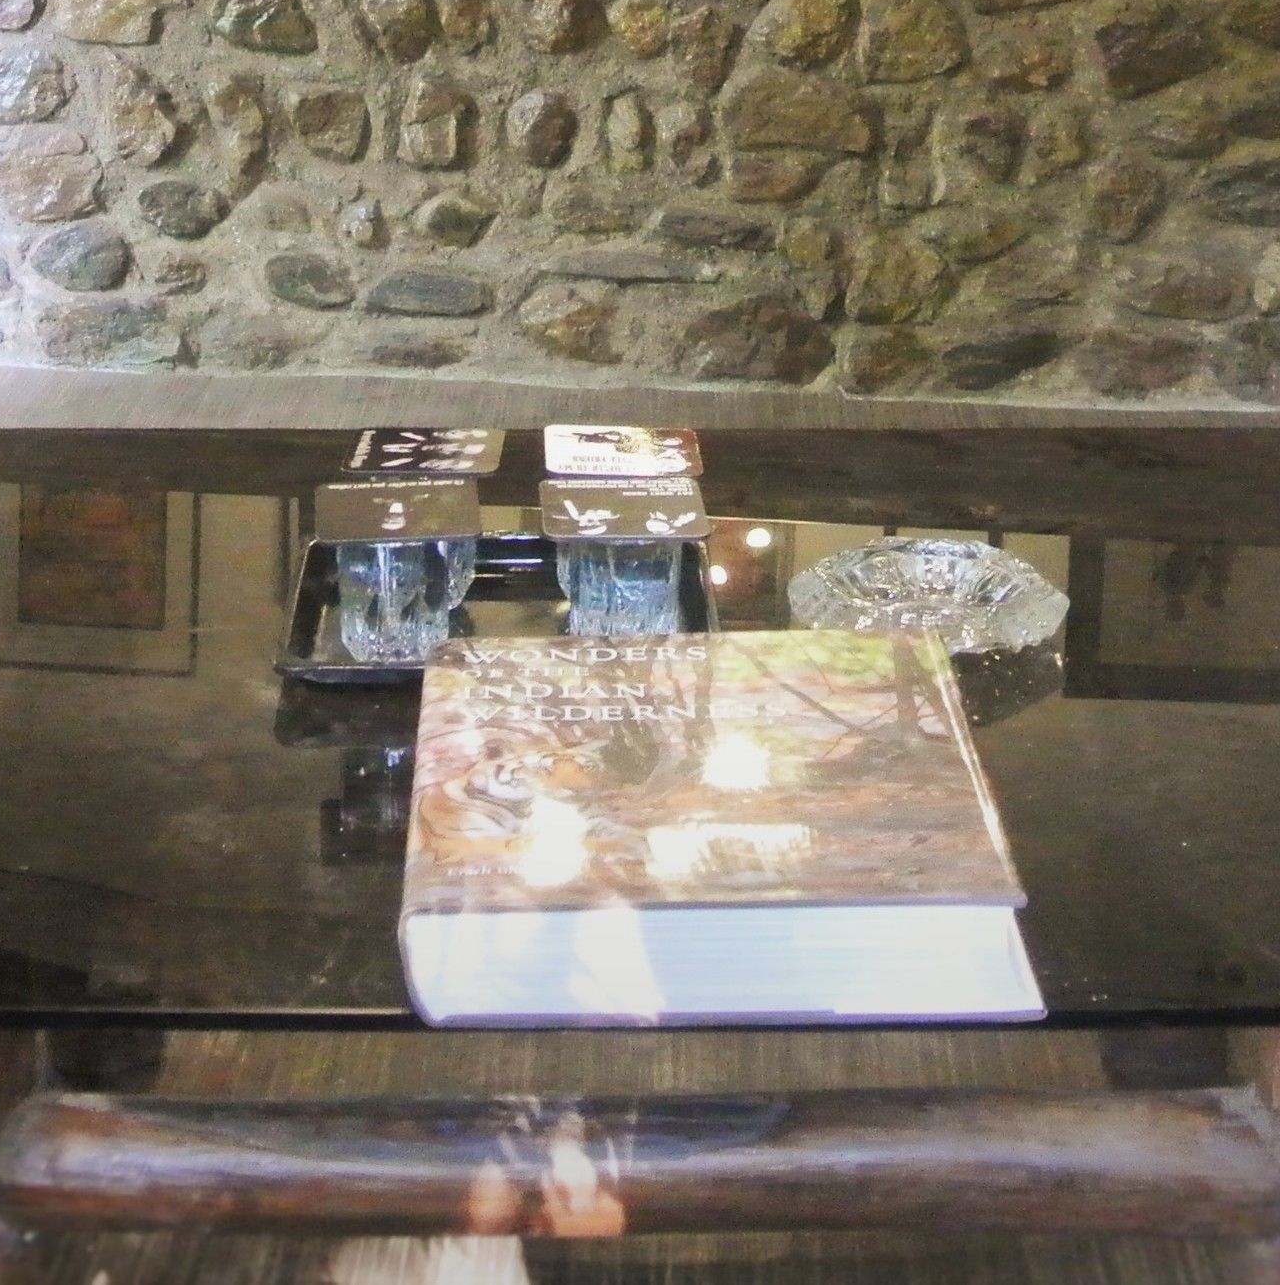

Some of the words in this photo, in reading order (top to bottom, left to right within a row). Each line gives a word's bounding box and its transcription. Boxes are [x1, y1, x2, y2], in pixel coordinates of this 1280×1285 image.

[461, 645, 708, 665] WONDERS
[462, 667, 502, 677] OF
[518, 666, 590, 677] THE
[462, 683, 647, 700] INDIAN
[459, 703, 788, 723] WILDERNESS
